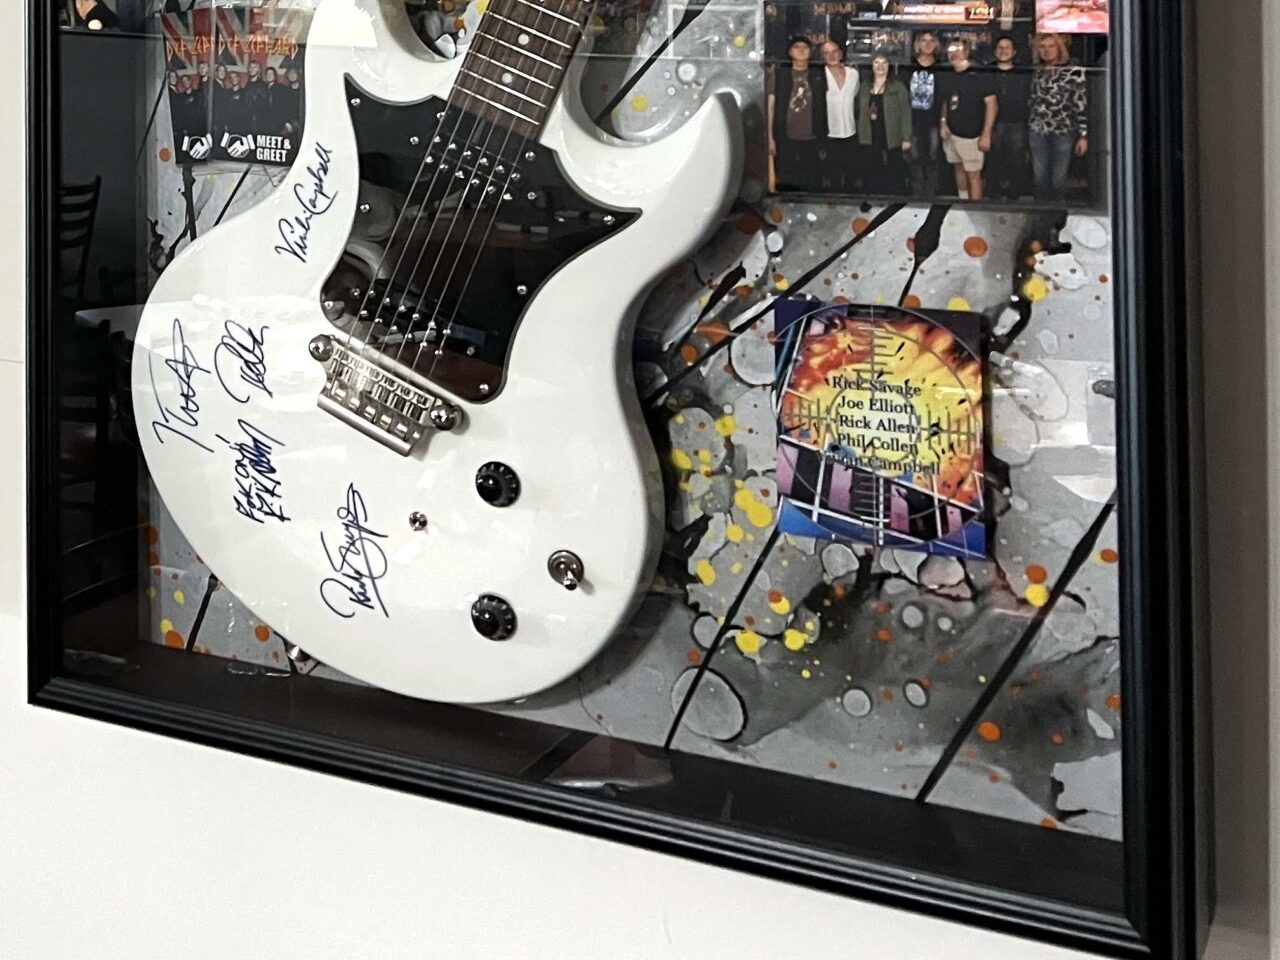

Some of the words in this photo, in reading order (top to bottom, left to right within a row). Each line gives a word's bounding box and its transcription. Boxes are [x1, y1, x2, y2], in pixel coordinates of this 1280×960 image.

[256, 134, 282, 149] MEET
[282, 138, 291, 150] &
[256, 148, 287, 162] GREET
[832, 376, 864, 391] Rick
[871, 380, 921, 398] Savage
[837, 395, 864, 410] Joe
[869, 397, 915, 416] Elliott
[839, 414, 871, 430] Rick
[876, 418, 916, 435] Allen
[837, 432, 865, 448] Phil
[871, 436, 918, 455] Collen
[869, 455, 940, 475] Campbell
